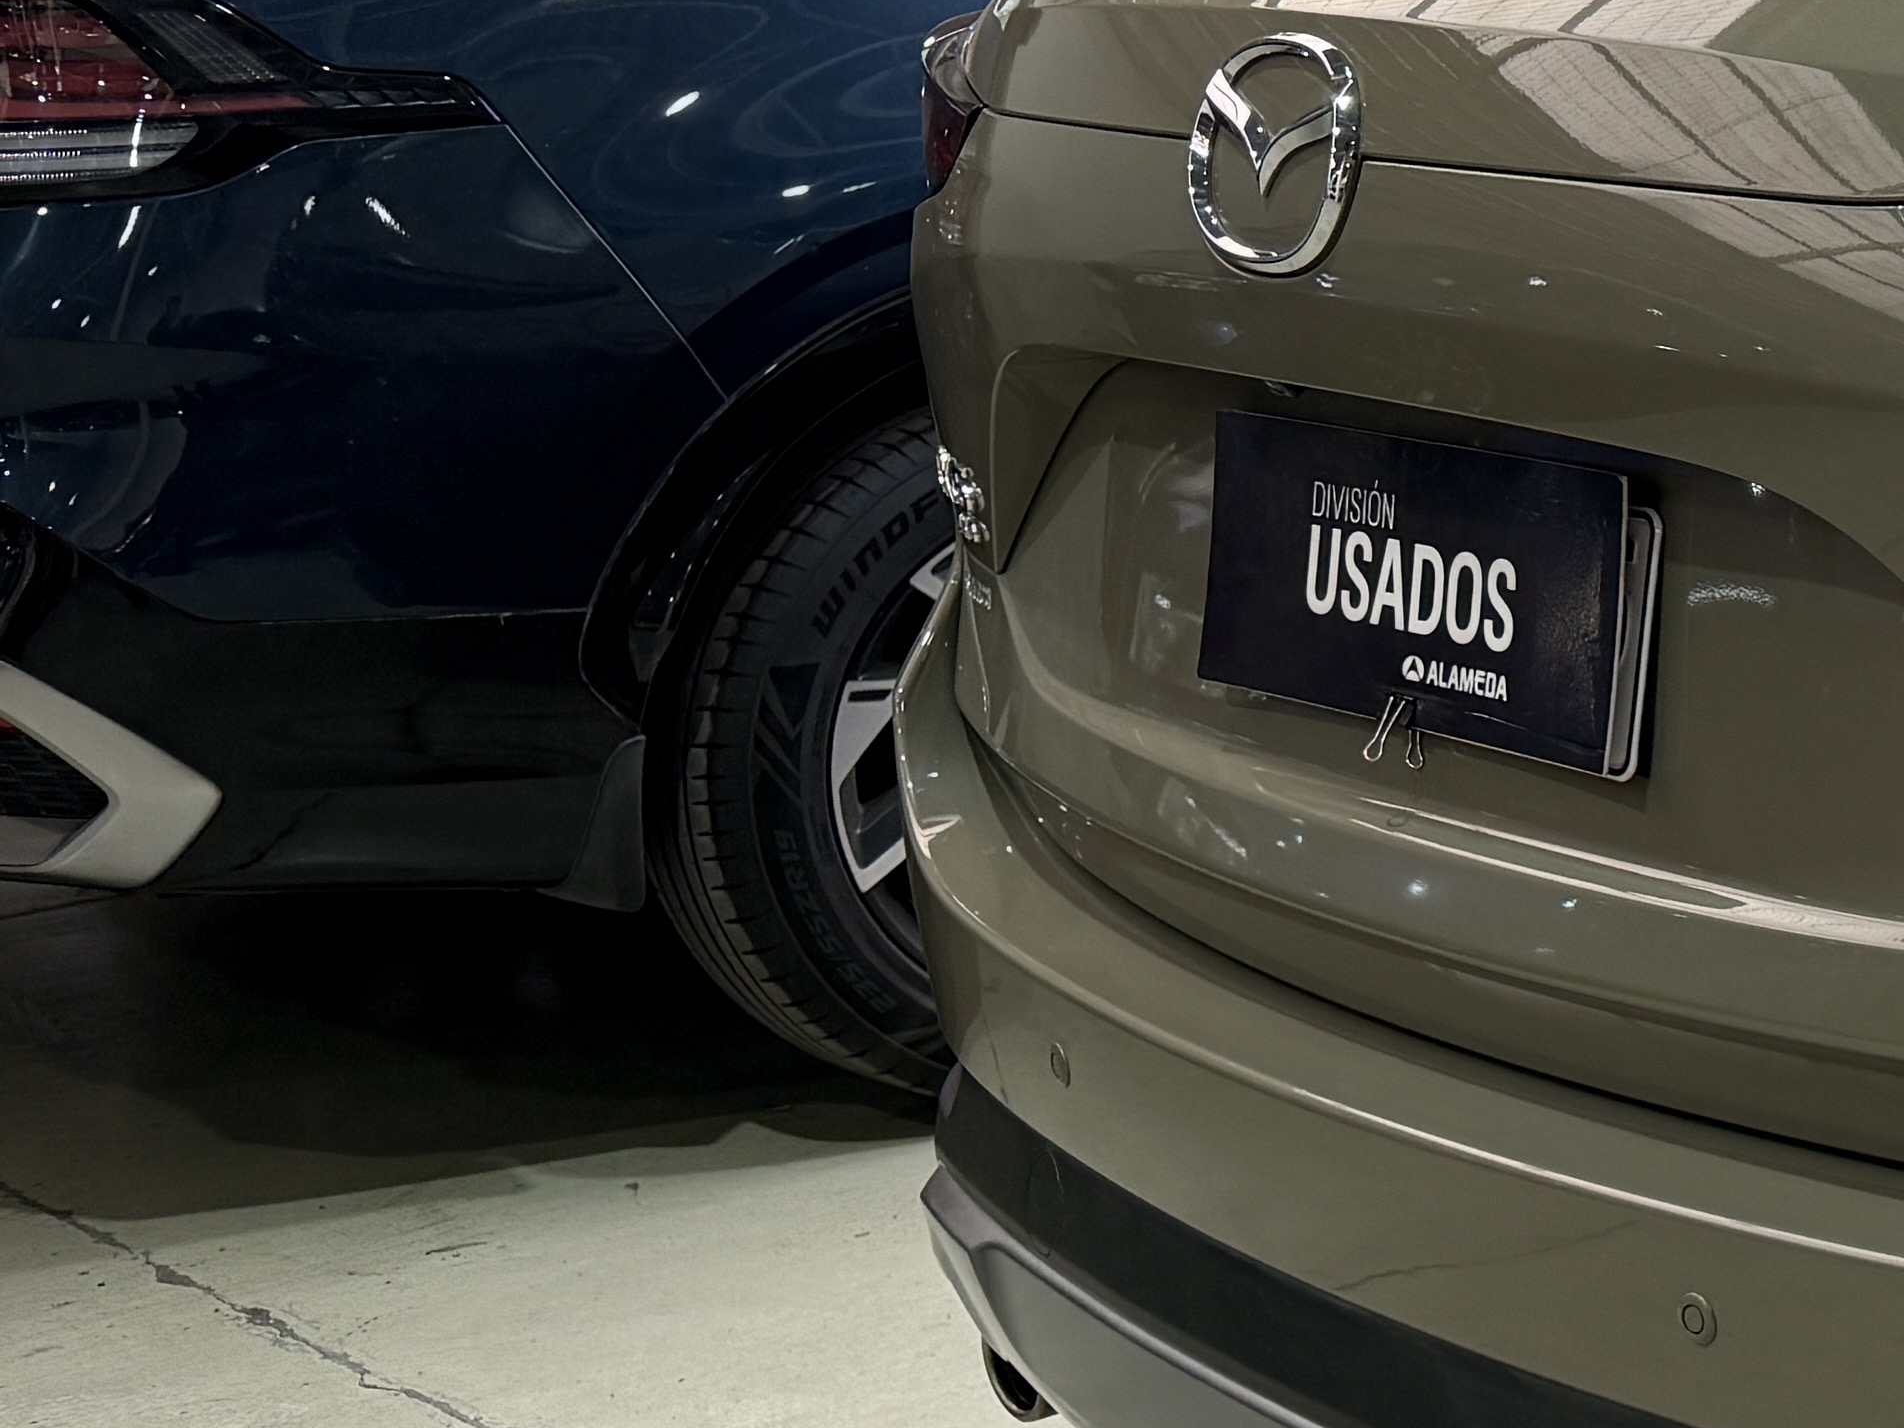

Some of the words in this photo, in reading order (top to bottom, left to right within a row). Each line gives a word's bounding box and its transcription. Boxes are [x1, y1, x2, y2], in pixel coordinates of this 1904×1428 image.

[1311, 479, 1396, 530] DIVISIÓN
[1305, 523, 1517, 653] USADOS
[1426, 660, 1508, 702] ALAMEDA
